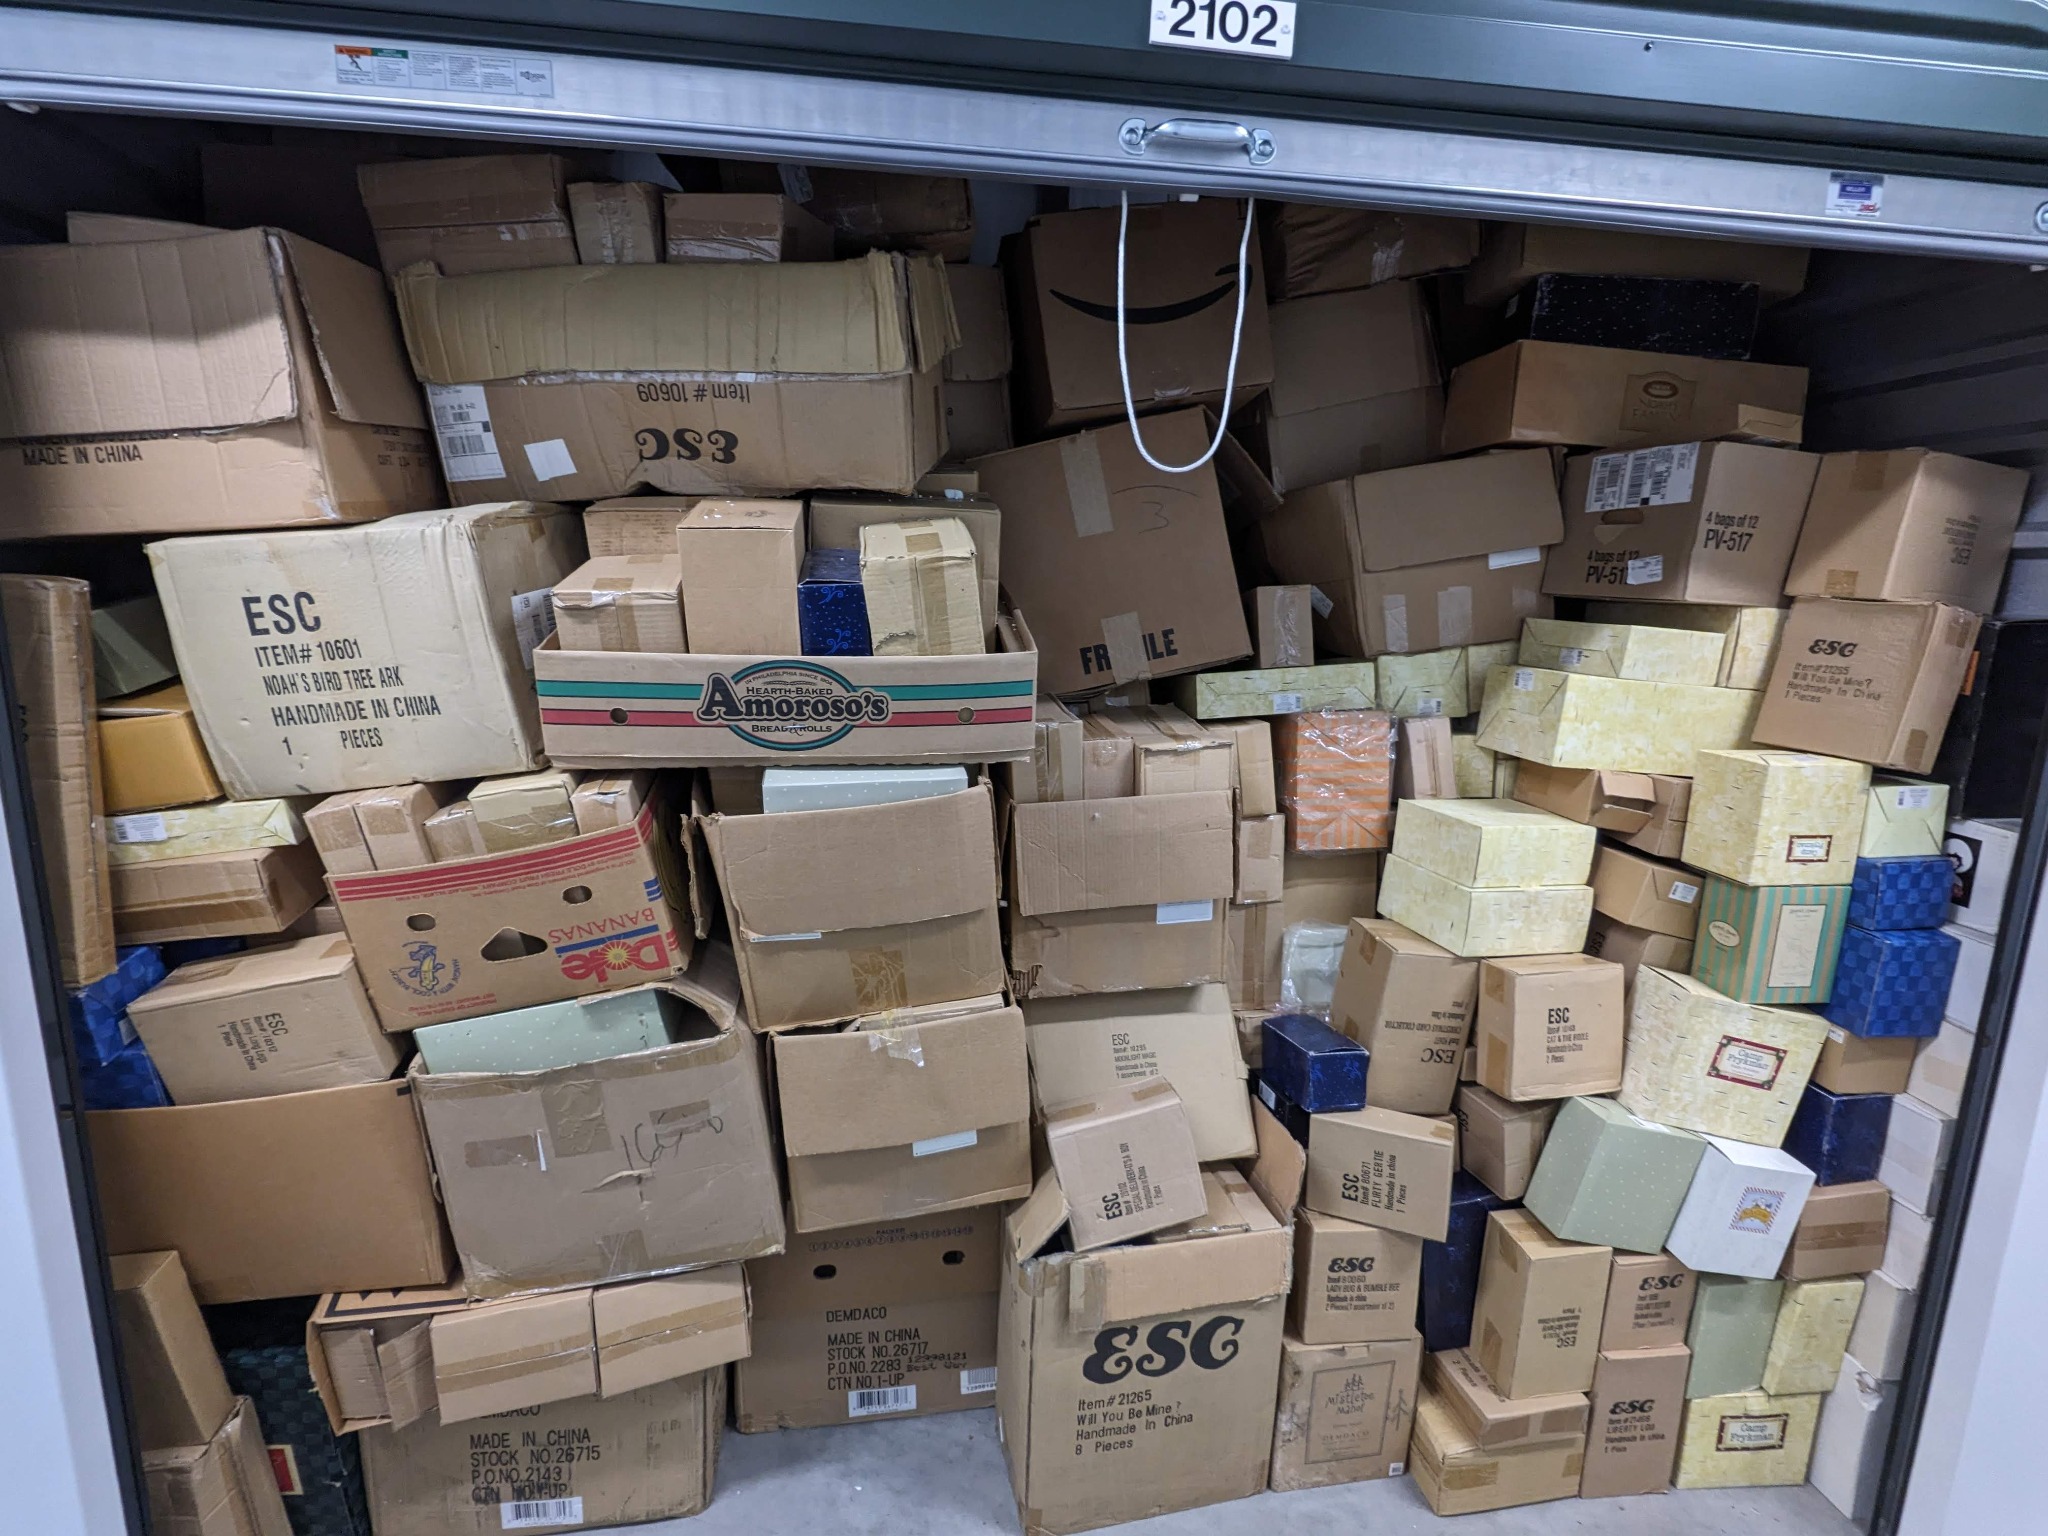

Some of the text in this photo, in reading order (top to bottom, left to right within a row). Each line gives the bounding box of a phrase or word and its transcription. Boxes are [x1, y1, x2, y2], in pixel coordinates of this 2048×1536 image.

[1169, 0, 1277, 47] 2102
[636, 382, 688, 402] 10609
[712, 383, 750, 403] Item
[23, 445, 142, 465] MADE IN CHINA
[635, 427, 739, 464] ESC
[1705, 511, 1760, 529] 4 bags of 12
[1704, 529, 1753, 552] PV-517
[1587, 551, 1594, 561] 4
[1594, 551, 1615, 564] bags
[1616, 550, 1625, 562] of
[241, 591, 321, 636] ESC
[254, 638, 362, 668] ITEM# 10601
[1079, 628, 1178, 675] FRILE
[1808, 638, 1859, 658] ESC
[262, 666, 404, 696] NOAH'S BIRD TREE ARK
[752, 671, 797, 681] PHILADELPHIA
[799, 672, 818, 680] SINCE
[701, 676, 889, 718] Amoroso's
[746, 686, 833, 695] HEARTH-BAKED
[1786, 681, 1832, 694] Handmade
[1853, 689, 1881, 701] China
[1792, 691, 1822, 702] Pieces
[271, 695, 441, 726] HANDMADE IN CHINA
[282, 727, 383, 755] 1 PIECES
[548, 907, 655, 944] BANANAS
[561, 933, 670, 983] Dole
[412, 988, 431, 996] COOL
[265, 1012, 288, 1036] ESC
[1548, 1007, 1570, 1024] ESC
[1384, 1020, 1461, 1034] CHRISTMAS CARD COLLECTOR
[221, 1031, 234, 1047] Piece
[227, 1021, 257, 1071] Handmade China
[249, 1035, 268, 1063] Long Legs
[1112, 1032, 1130, 1046] ESC
[1547, 1035, 1556, 1043] CAT
[1114, 1051, 1157, 1062] MOONLIGHT MAGIC
[1421, 1048, 1456, 1064] ESC
[1738, 1049, 1763, 1062] Camp
[1119, 1142, 1130, 1153] BOY
[1361, 1161, 1371, 1184] 80671
[1371, 1149, 1384, 1208] FLIRTY GERTIE
[1138, 1165, 1154, 1210] Handmade China
[1153, 1185, 1163, 1199] Piece
[1341, 1173, 1360, 1202] ESC
[1384, 1180, 1395, 1211] Handmade
[1102, 1192, 1123, 1220] ESC
[1131, 1191, 1144, 1213] SPECIAL
[1328, 1257, 1375, 1273] ESC
[1326, 1284, 1342, 1292] LADY
[1343, 1284, 1355, 1292] BUG
[1363, 1283, 1387, 1292] BUMBLE
[1388, 1283, 1400, 1291] BEE
[1639, 1273, 1684, 1290] ESC
[826, 1307, 887, 1323] DEMDACO
[827, 1328, 920, 1346] MADE IN CHINA
[1557, 1336, 1576, 1348] ESC
[827, 1341, 929, 1361] STOCK NO.26717
[1083, 1315, 1245, 1384] ESC
[827, 1358, 901, 1375] P.O.NO.2283
[827, 1373, 904, 1391] CTN NO.1-UP
[1118, 1389, 1152, 1405] 21265
[1609, 1399, 1655, 1415] ESC
[1077, 1413, 1096, 1426] Will
[1102, 1410, 1123, 1423] You
[1128, 1408, 1143, 1419] Be
[1146, 1404, 1172, 1417] Mine
[1076, 1413, 1193, 1441] Handmade In China
[1607, 1425, 1637, 1434] LIBERTY
[1741, 1422, 1768, 1433] Camp
[470, 1428, 591, 1449] MADE IN CHINA
[1075, 1439, 1133, 1455] 8 Pieces
[1730, 1433, 1774, 1443] Frykman
[471, 1445, 600, 1468] STOCK NO.26715
